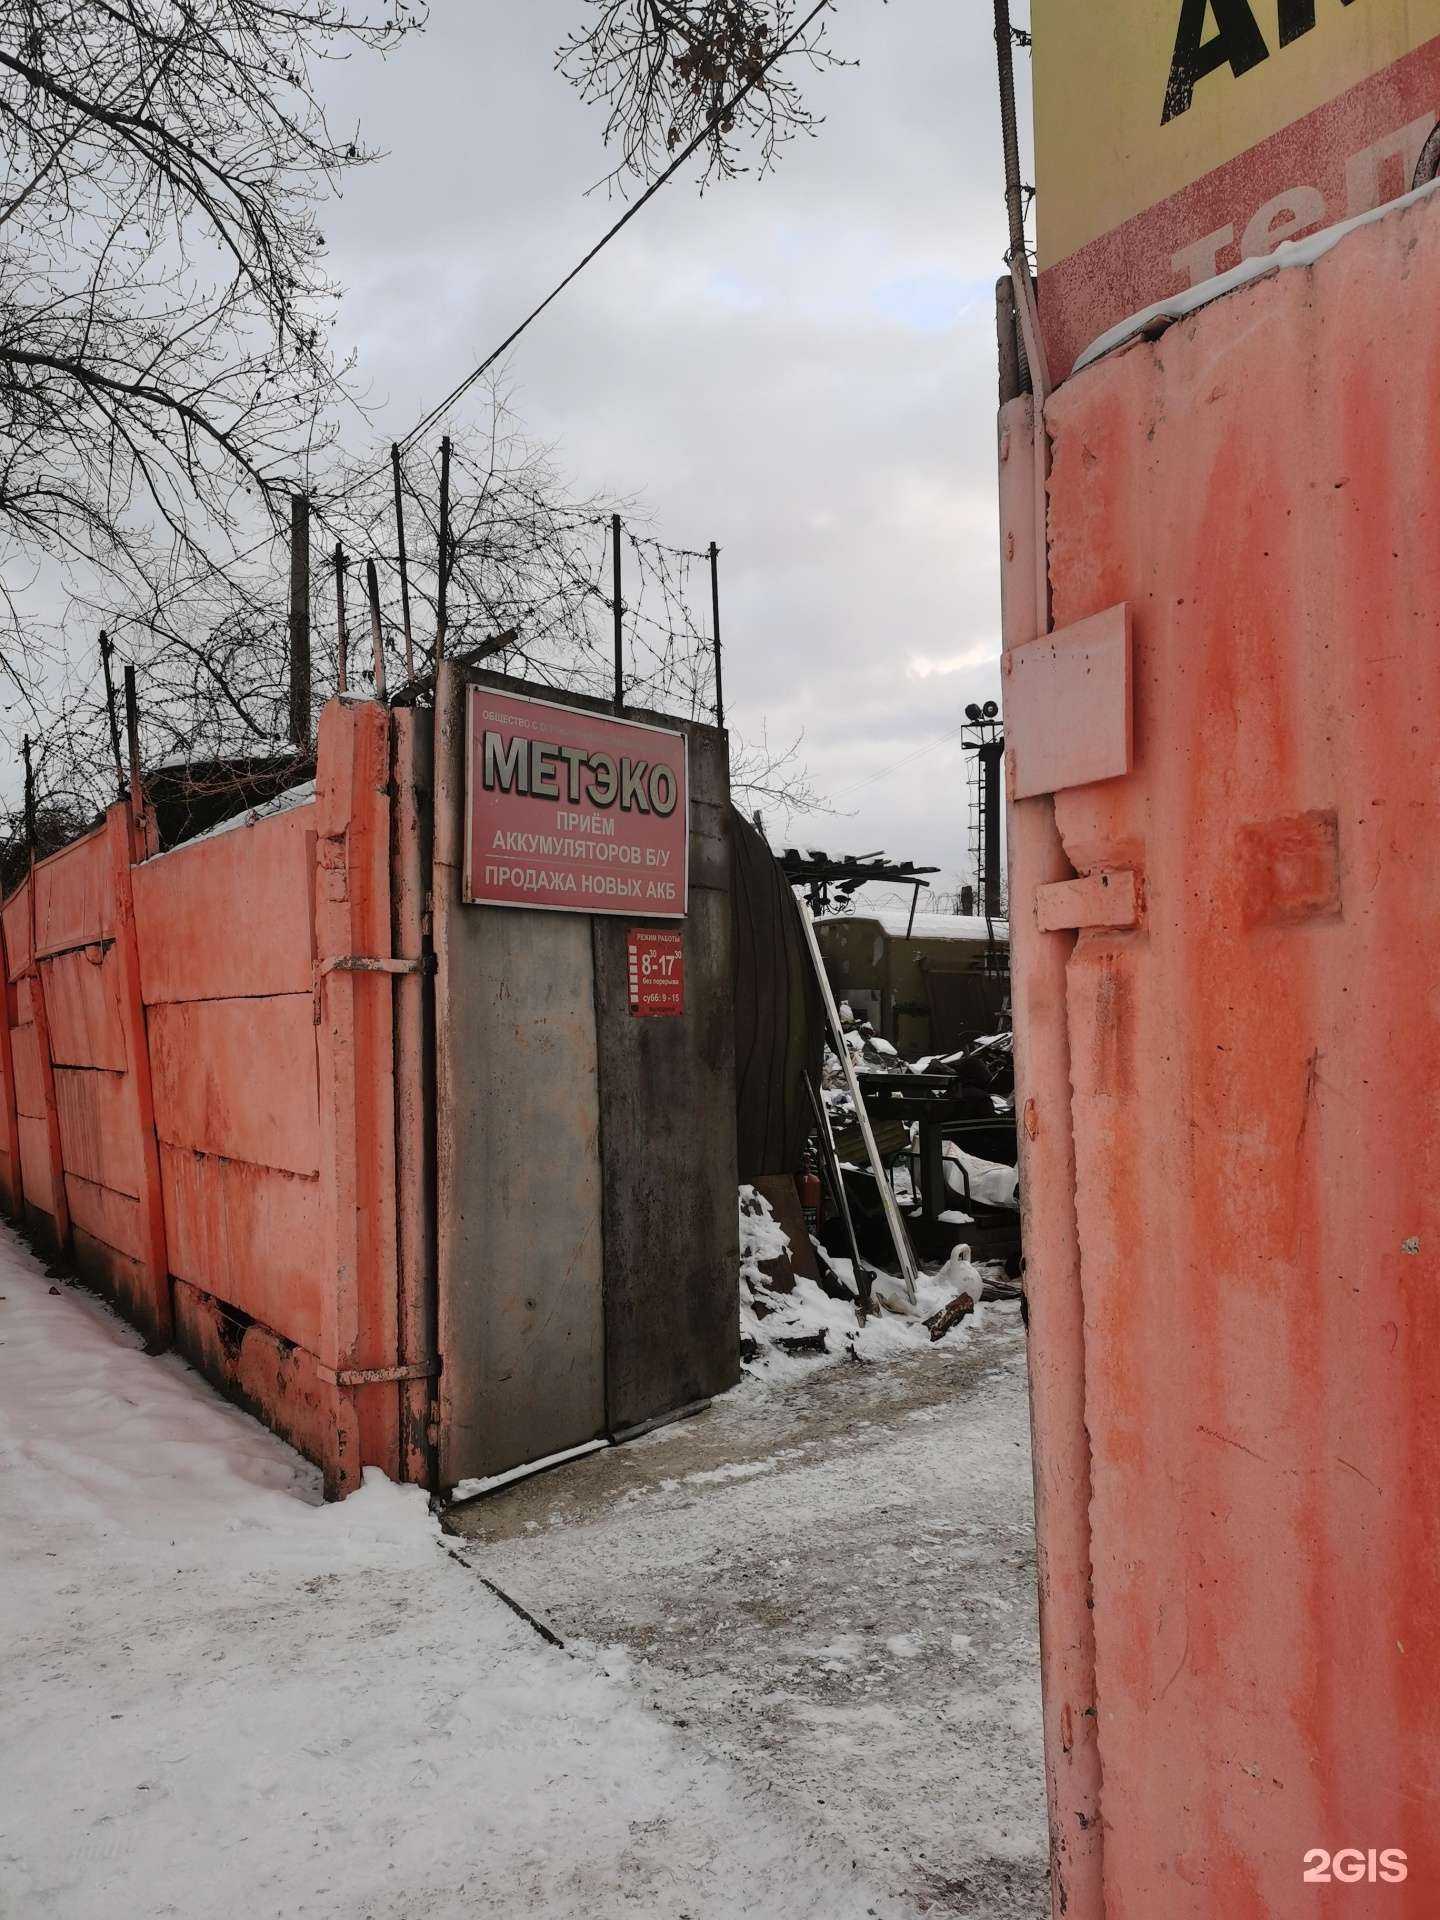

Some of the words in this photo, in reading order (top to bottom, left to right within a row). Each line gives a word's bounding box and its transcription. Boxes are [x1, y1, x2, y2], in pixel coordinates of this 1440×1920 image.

[484, 730, 678, 818] МЕТЭКО
[556, 810, 615, 837] ПРИЁМ
[492, 829, 641, 865] АККУМУЛЯТОРОВ
[646, 848, 671, 867] Б/У
[485, 865, 577, 892] ПРОДАЖА
[582, 874, 642, 897] НОВЫХ
[645, 881, 676, 900] АКБ
